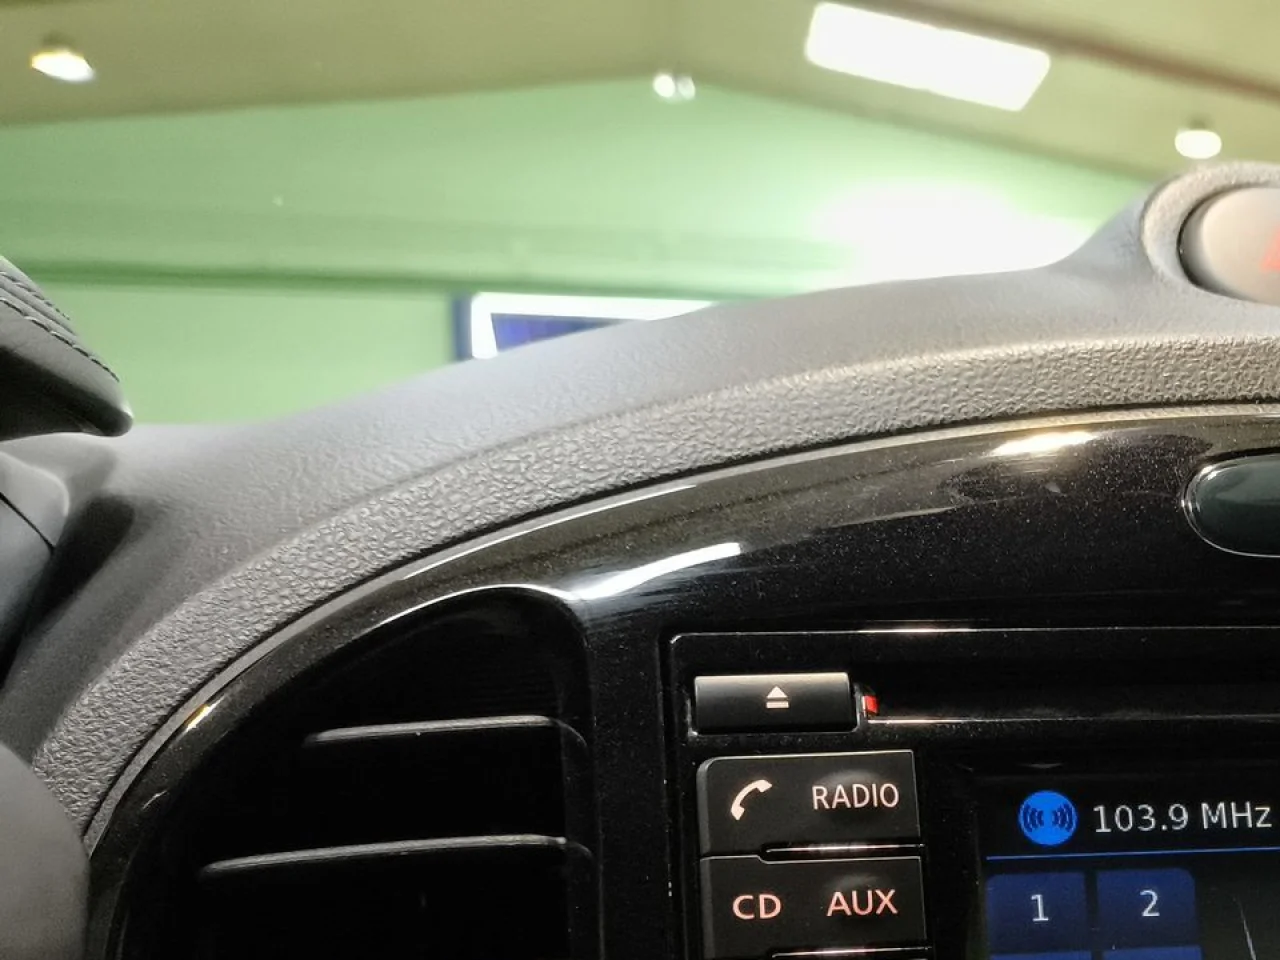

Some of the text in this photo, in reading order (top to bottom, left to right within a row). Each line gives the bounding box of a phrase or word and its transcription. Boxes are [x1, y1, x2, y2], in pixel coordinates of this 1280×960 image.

[812, 783, 900, 810] RADIO
[1093, 801, 1273, 833] 103.9 MHz
[732, 893, 782, 920] CD
[827, 889, 898, 917] AUX
[1031, 894, 1049, 922] 1
[1140, 889, 1160, 917] 2
